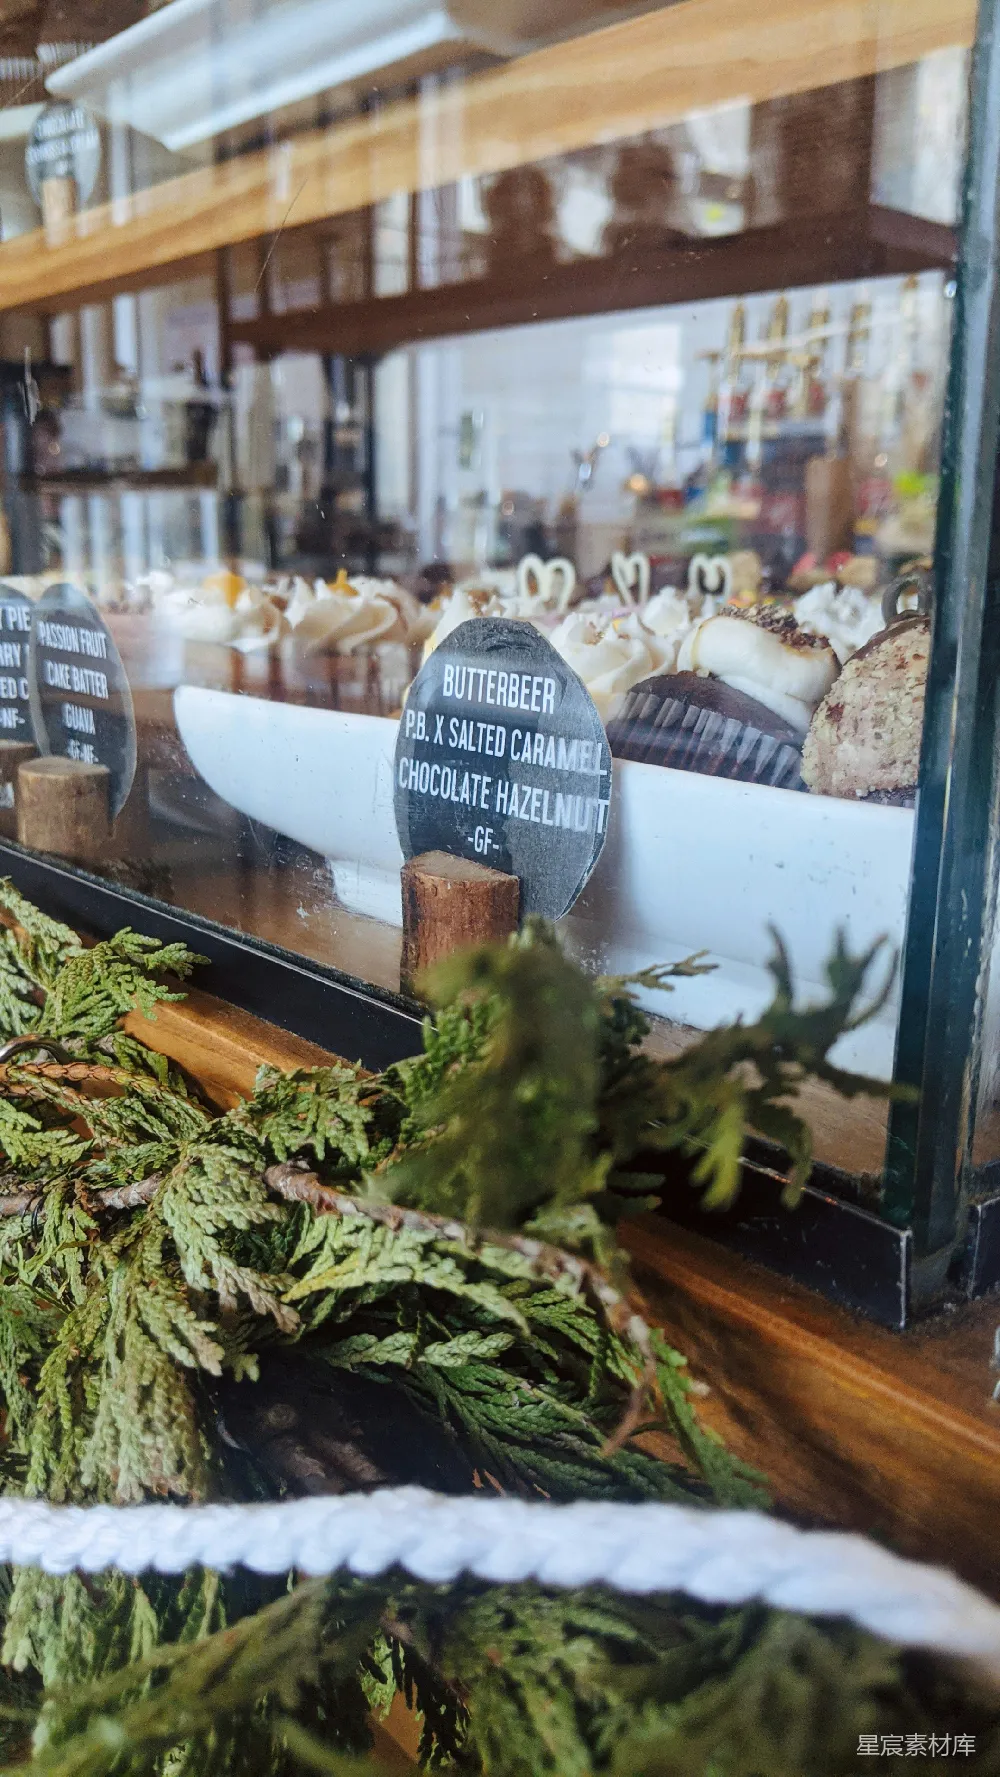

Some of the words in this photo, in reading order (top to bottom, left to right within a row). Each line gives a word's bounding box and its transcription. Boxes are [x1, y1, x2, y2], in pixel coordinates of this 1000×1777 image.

[5, 605, 31, 631] PIE
[37, 621, 80, 652] PASSION
[80, 628, 107, 659] FRUIT
[46, 660, 72, 688] CAKE
[72, 668, 109, 699] BATTER
[443, 664, 556, 714] BUTTERBEER
[62, 702, 96, 735] GUAVA
[405, 709, 429, 742] P.B.
[434, 713, 444, 746] X
[448, 717, 507, 758] SALTED
[510, 729, 608, 776] CARAMEL
[399, 758, 492, 810] CHOCOLATE
[496, 780, 610, 834] HAZELNUT
[467, 826, 500, 855] -GF-
